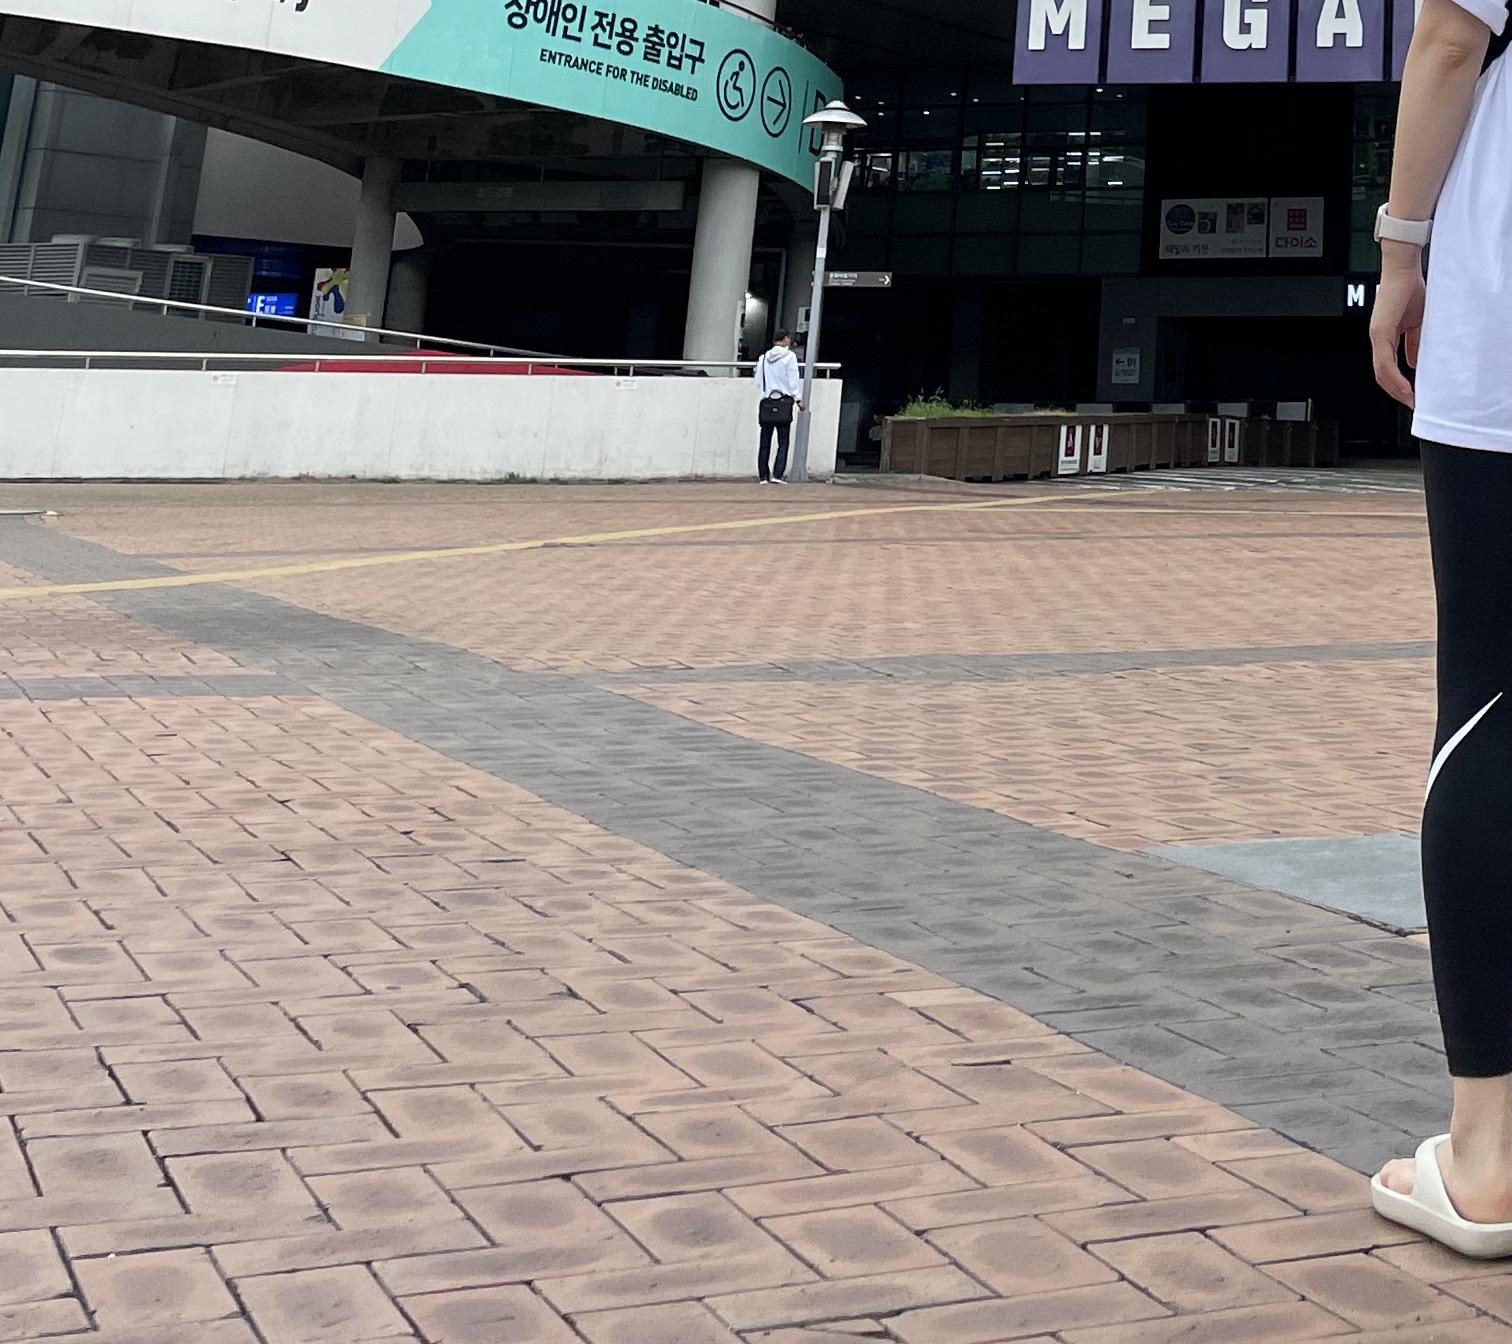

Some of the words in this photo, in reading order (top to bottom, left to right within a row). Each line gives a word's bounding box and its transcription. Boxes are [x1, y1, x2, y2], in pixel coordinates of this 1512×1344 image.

[590, 9, 641, 57] 전용
[642, 24, 706, 75] 출입구
[539, 48, 603, 77] ENTRANCE
[605, 64, 628, 83] FOR
[630, 70, 650, 88] THE
[651, 77, 699, 102] DISABLED
[1274, 236, 1318, 249] 다이소
[1346, 283, 1365, 307] M
